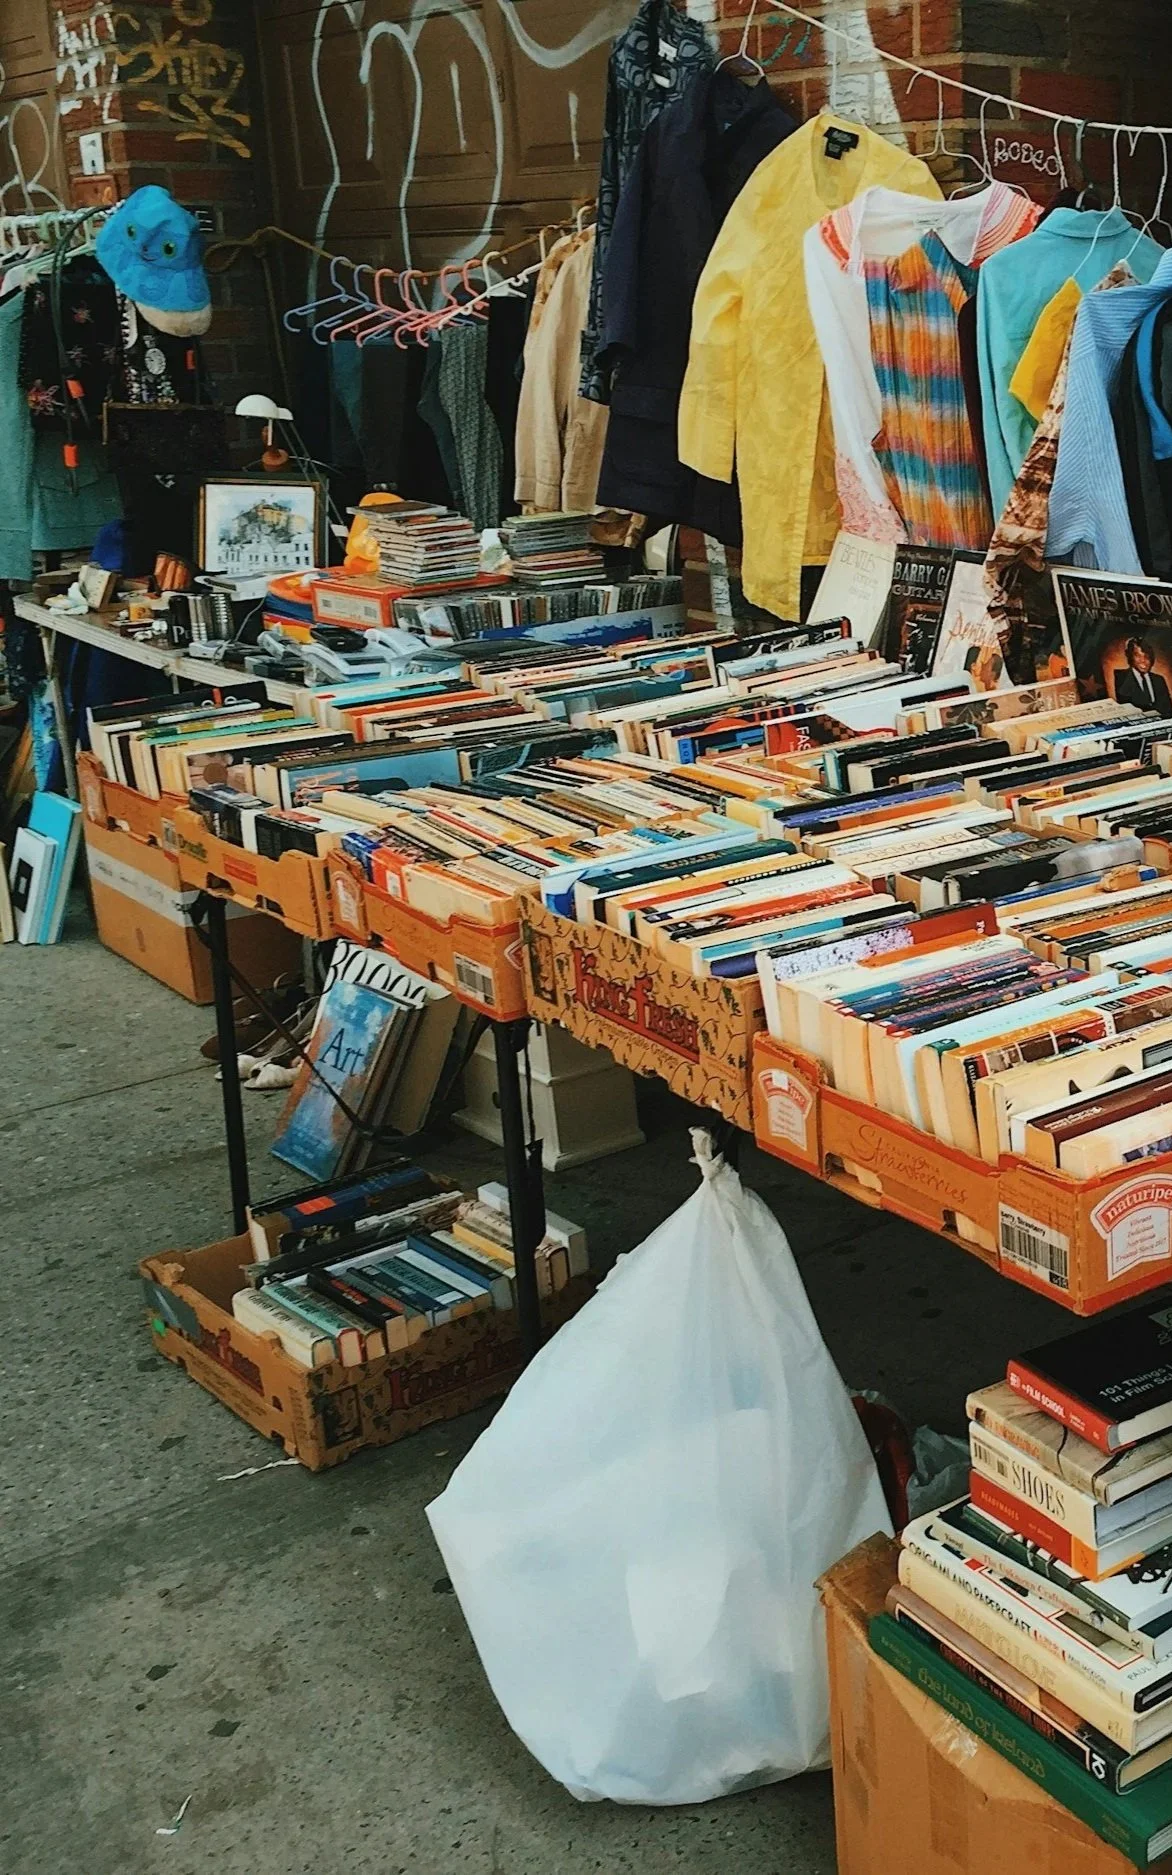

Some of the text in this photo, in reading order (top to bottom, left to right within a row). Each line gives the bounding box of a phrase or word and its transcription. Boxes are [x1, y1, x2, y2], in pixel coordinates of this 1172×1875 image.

[894, 561, 935, 585] BARRY
[1060, 582, 1118, 610] JAMES
[318, 1027, 366, 1077] Art
[1099, 1381, 1123, 1399] 101
[1123, 1365, 1164, 1390] Things
[1110, 1393, 1125, 1404] in
[1126, 1380, 1152, 1397] Film
[1011, 1459, 1066, 1521] SHOES
[908, 1541, 954, 1577] ORIGAMI
[951, 1572, 973, 1597] AND
[973, 1588, 1032, 1638] PAPERCRAFT
